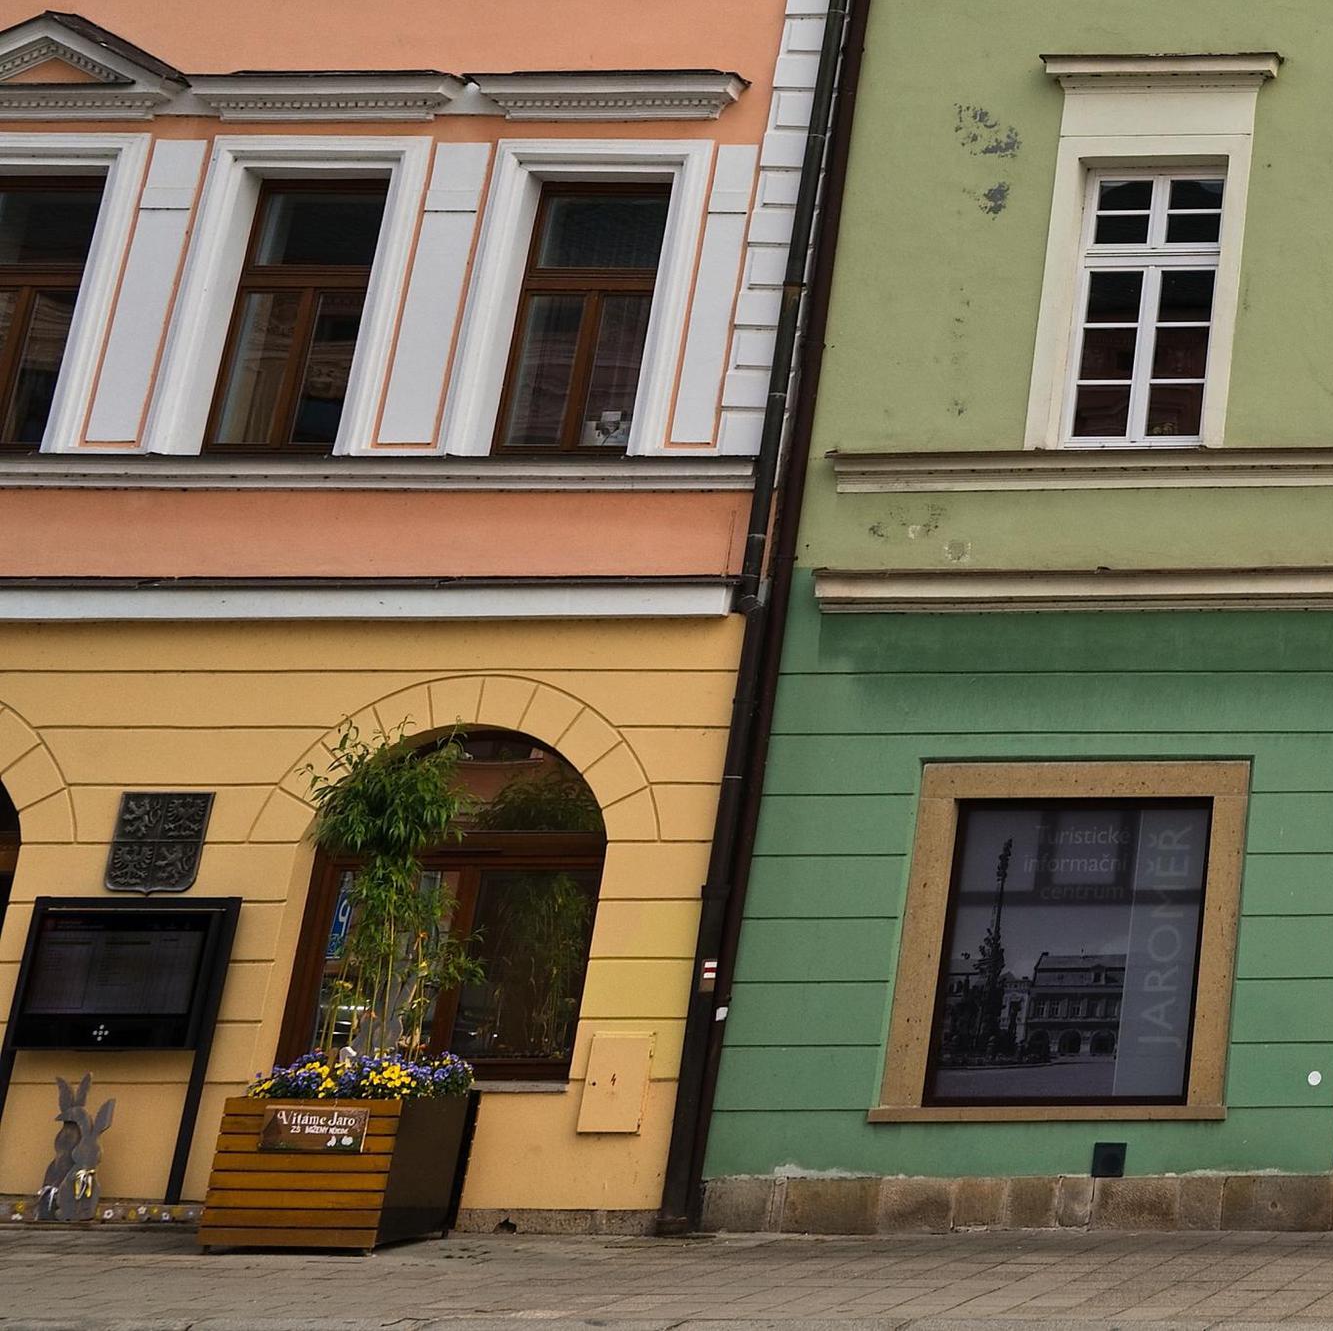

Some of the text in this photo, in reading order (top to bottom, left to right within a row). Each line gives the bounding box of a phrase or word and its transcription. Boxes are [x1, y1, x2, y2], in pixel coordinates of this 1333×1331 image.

[1034, 824, 1130, 845] Turistické
[1023, 851, 1128, 873] informační
[1040, 884, 1125, 900] centrum
[1138, 823, 1194, 1047] JAROMĚŘ
[328, 1111, 356, 1126] Jaro
